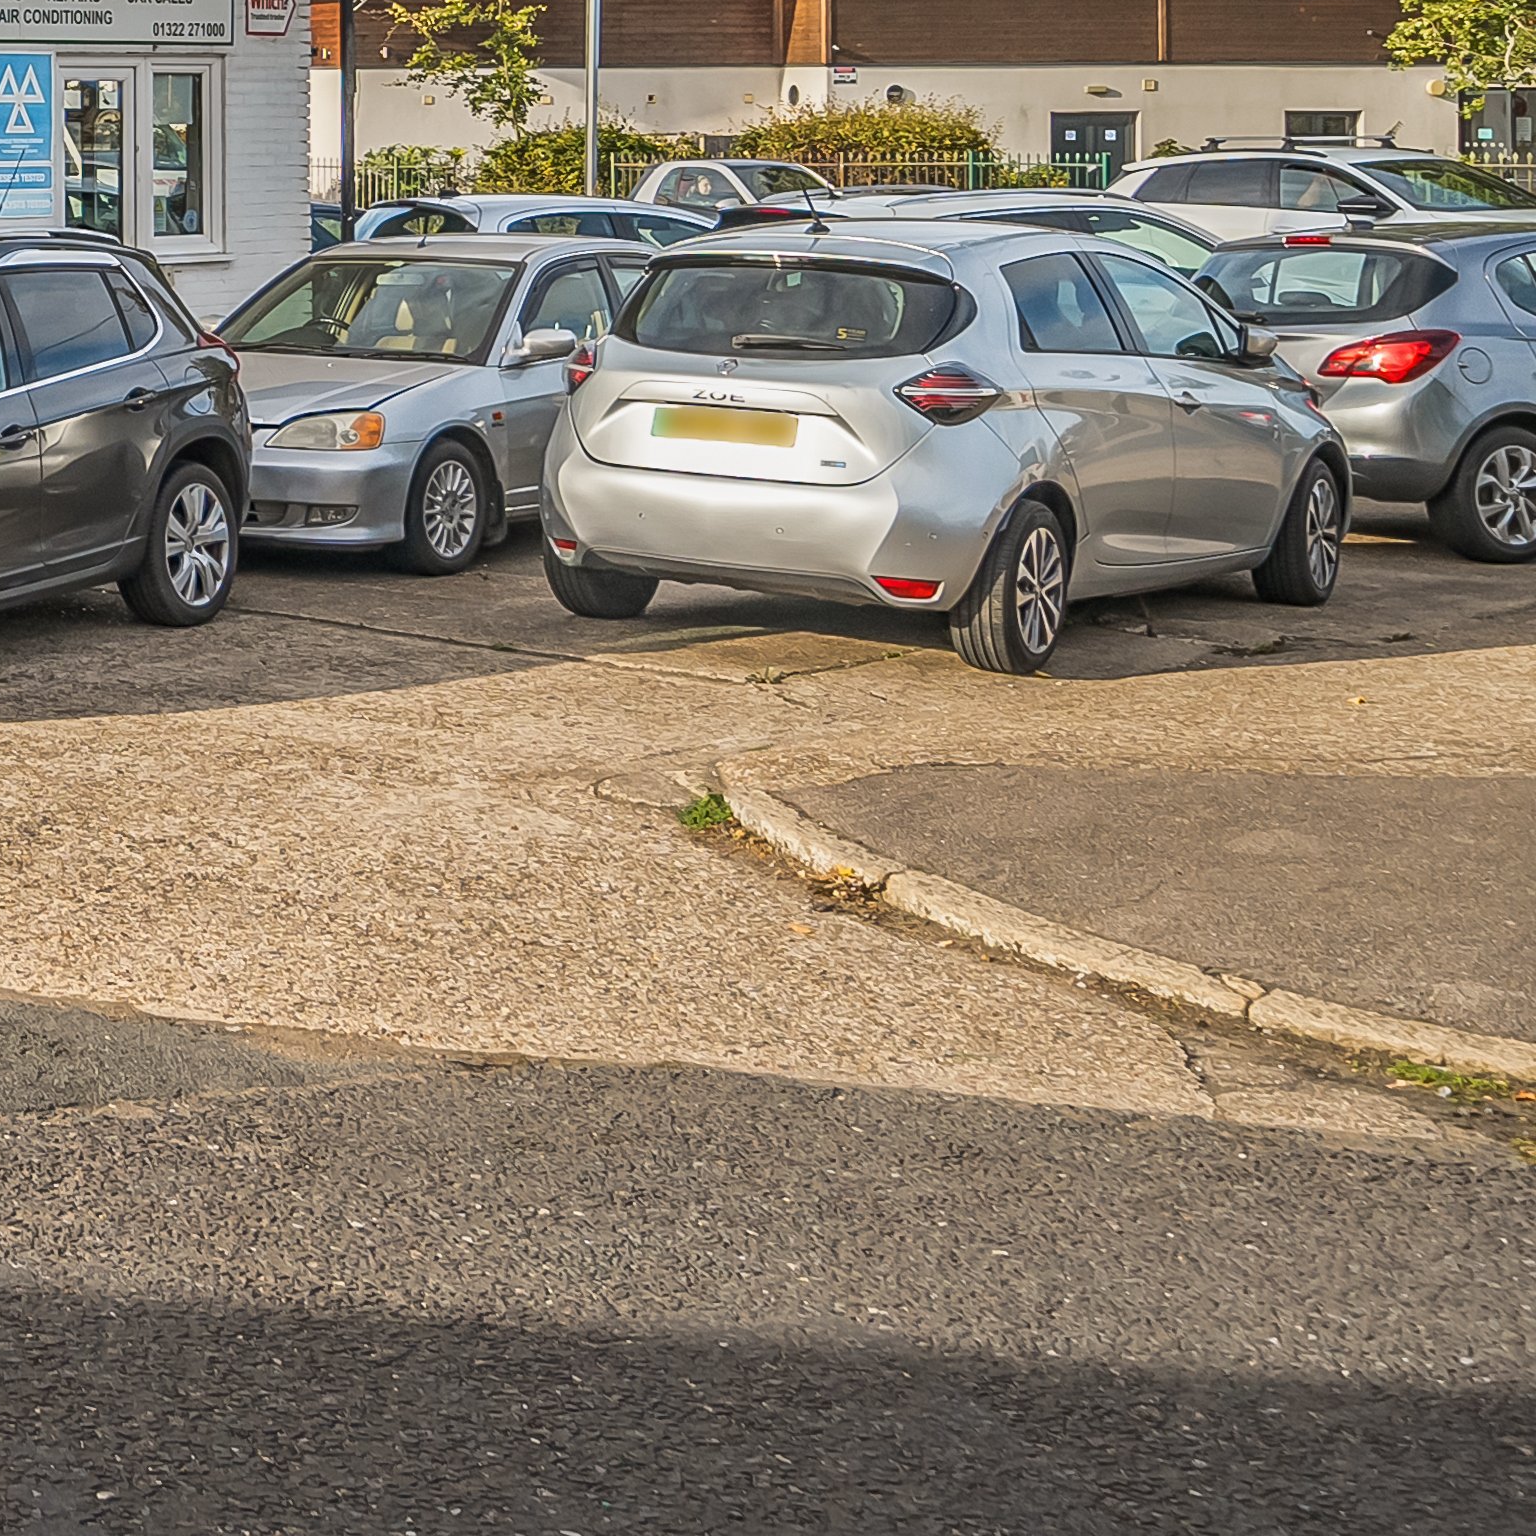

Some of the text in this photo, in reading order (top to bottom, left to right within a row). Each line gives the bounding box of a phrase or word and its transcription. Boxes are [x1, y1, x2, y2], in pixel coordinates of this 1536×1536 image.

[23, 9, 113, 25] CONDITIONING
[153, 22, 225, 38] 01322 271000
[692, 389, 746, 403] ZOE
